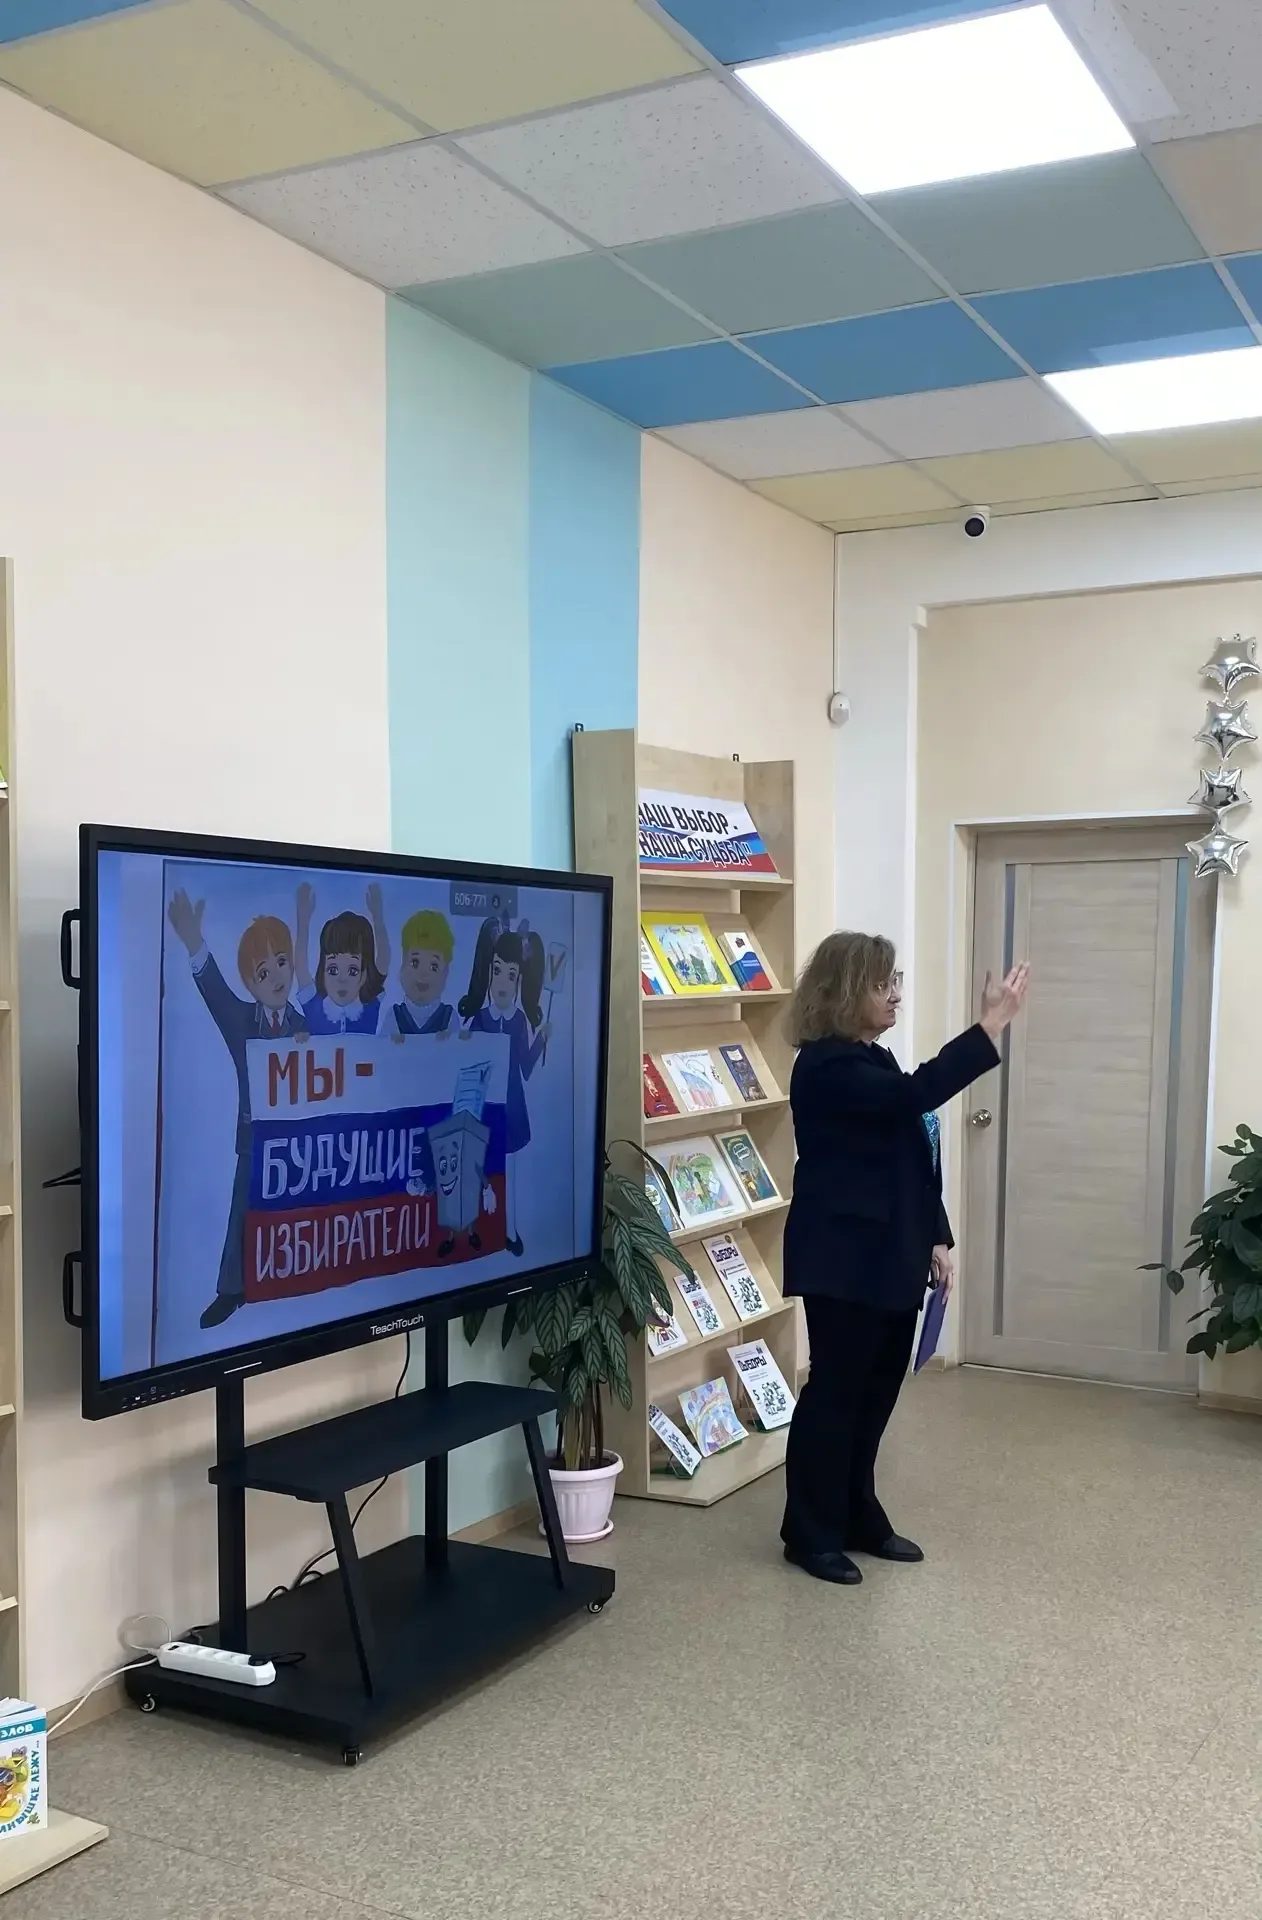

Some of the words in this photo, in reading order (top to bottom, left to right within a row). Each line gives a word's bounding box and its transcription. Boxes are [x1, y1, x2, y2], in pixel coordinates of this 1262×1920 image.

[638, 802, 675, 828] НАШ
[671, 806, 729, 835] ВЫБОР
[639, 831, 692, 859] НАША
[268, 1048, 345, 1107] МЫ
[262, 1127, 426, 1200] БУДУЩИЕ
[256, 1202, 431, 1283] ИЗБИРАТЕЛИ
[370, 1314, 424, 1336] TeachTouch
[0, 1723, 34, 1738] ЗЛОВ
